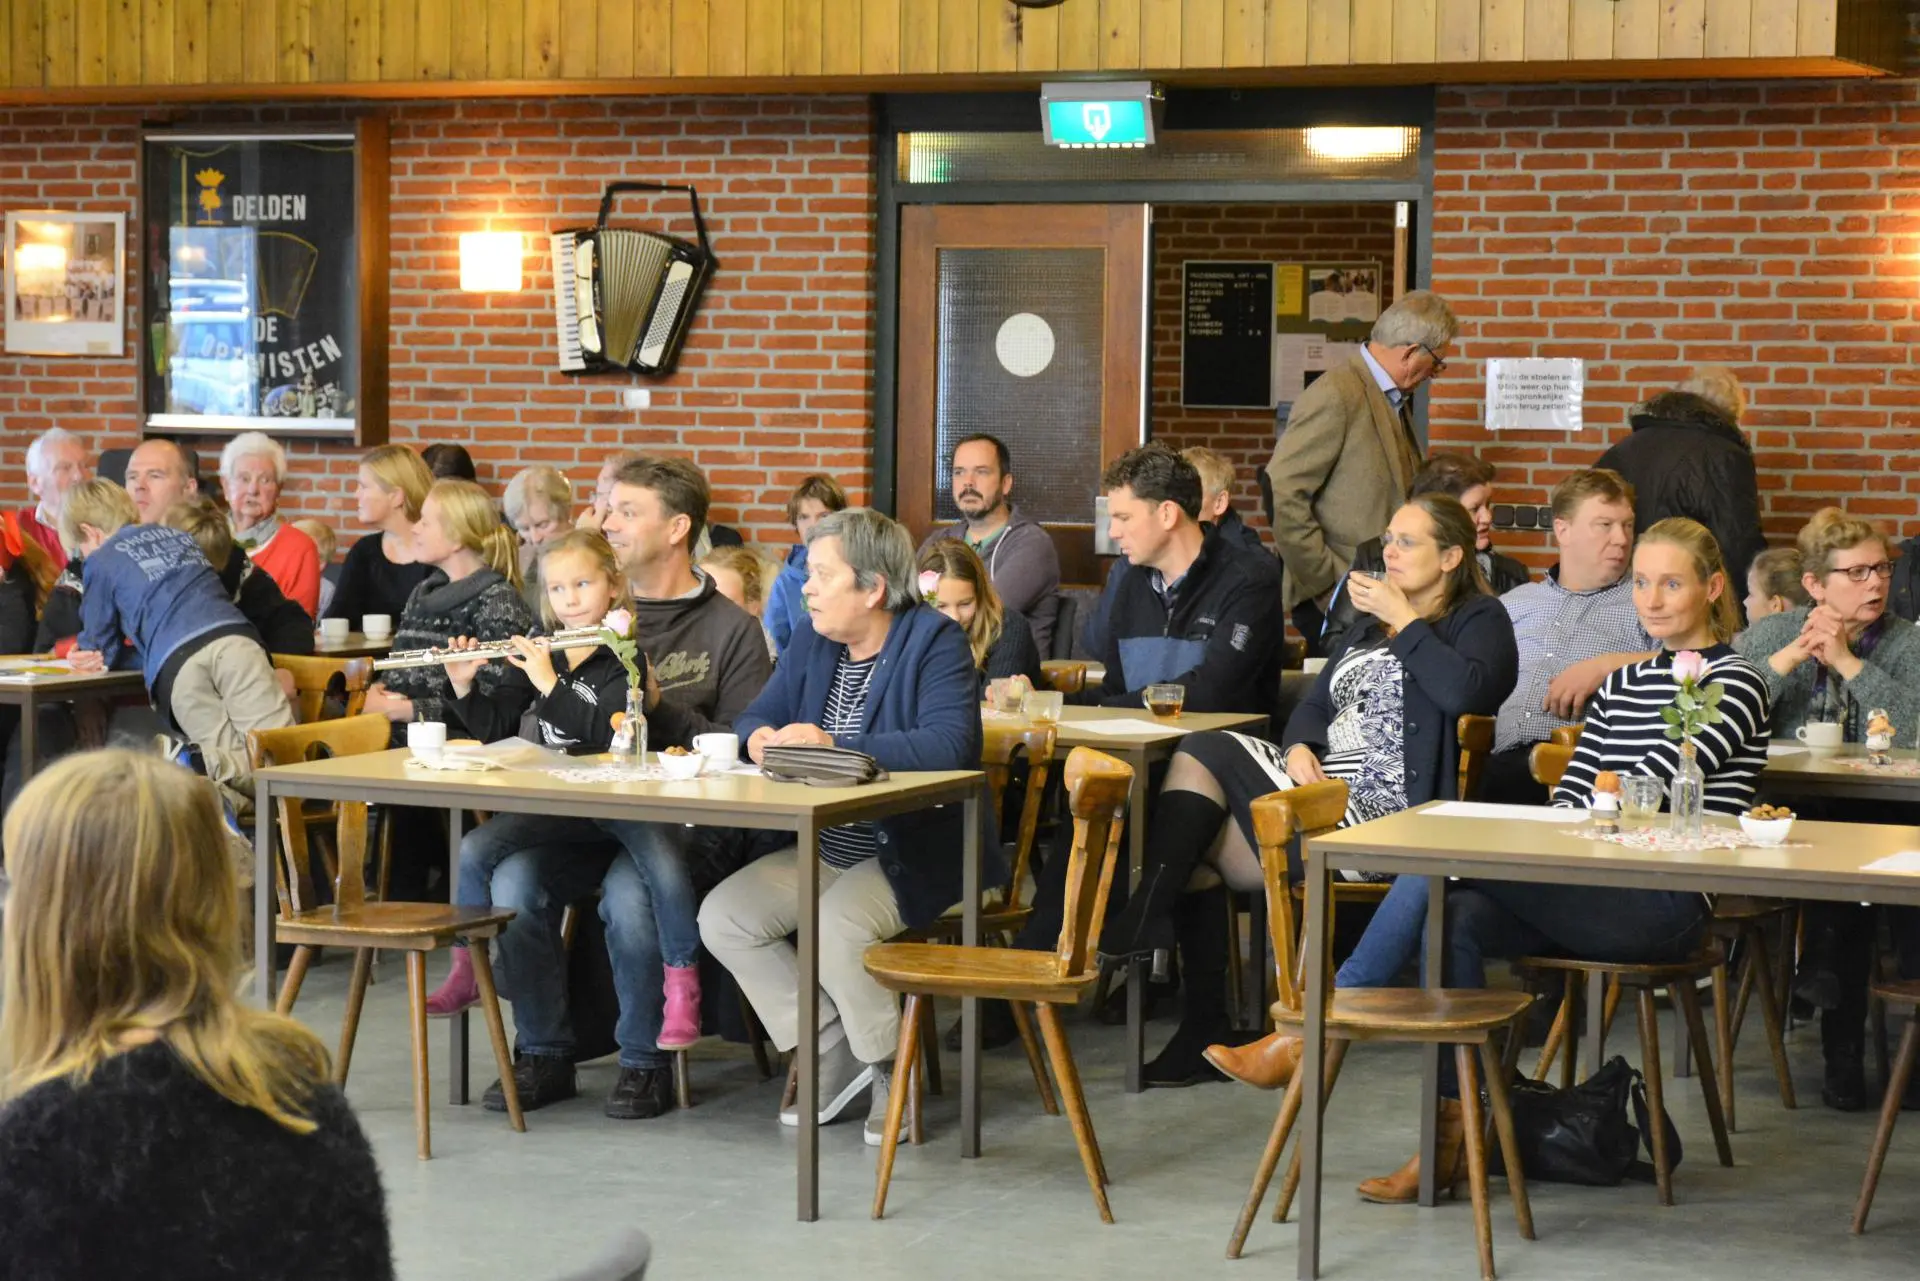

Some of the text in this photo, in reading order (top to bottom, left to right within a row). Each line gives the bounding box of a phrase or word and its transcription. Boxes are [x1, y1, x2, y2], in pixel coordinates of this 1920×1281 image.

[232, 194, 307, 221] DELDEN
[253, 316, 278, 343] DE
[1519, 403, 1540, 411] terug
